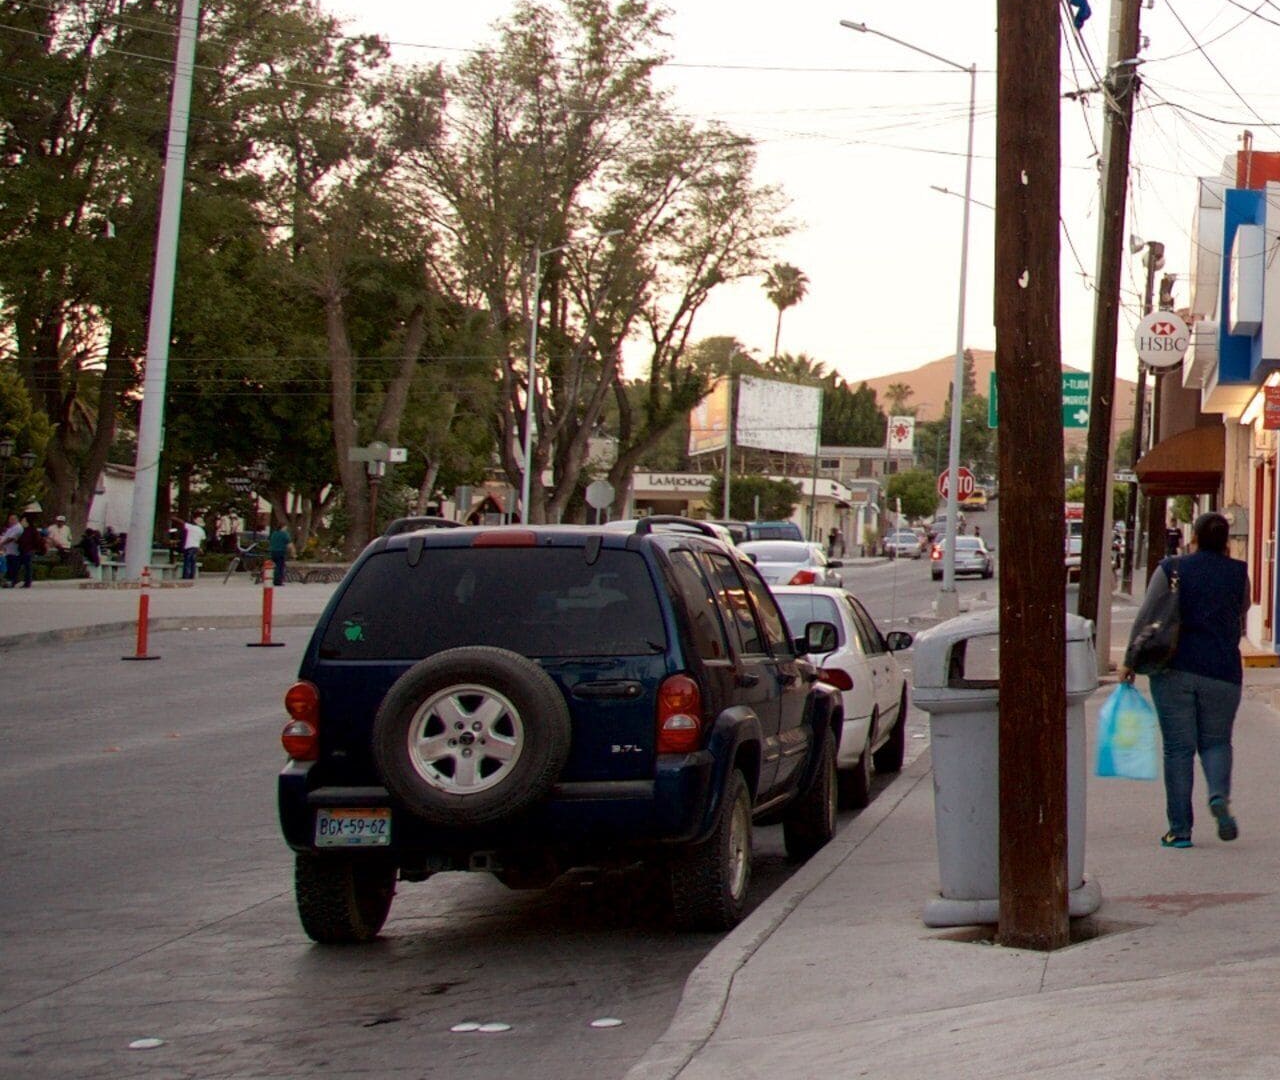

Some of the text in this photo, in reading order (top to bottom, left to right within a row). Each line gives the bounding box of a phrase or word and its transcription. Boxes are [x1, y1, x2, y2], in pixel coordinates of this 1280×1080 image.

[1140, 336, 1187, 352] HSBC
[941, 475, 973, 494] ATO
[320, 817, 386, 836] BGX-59-62
